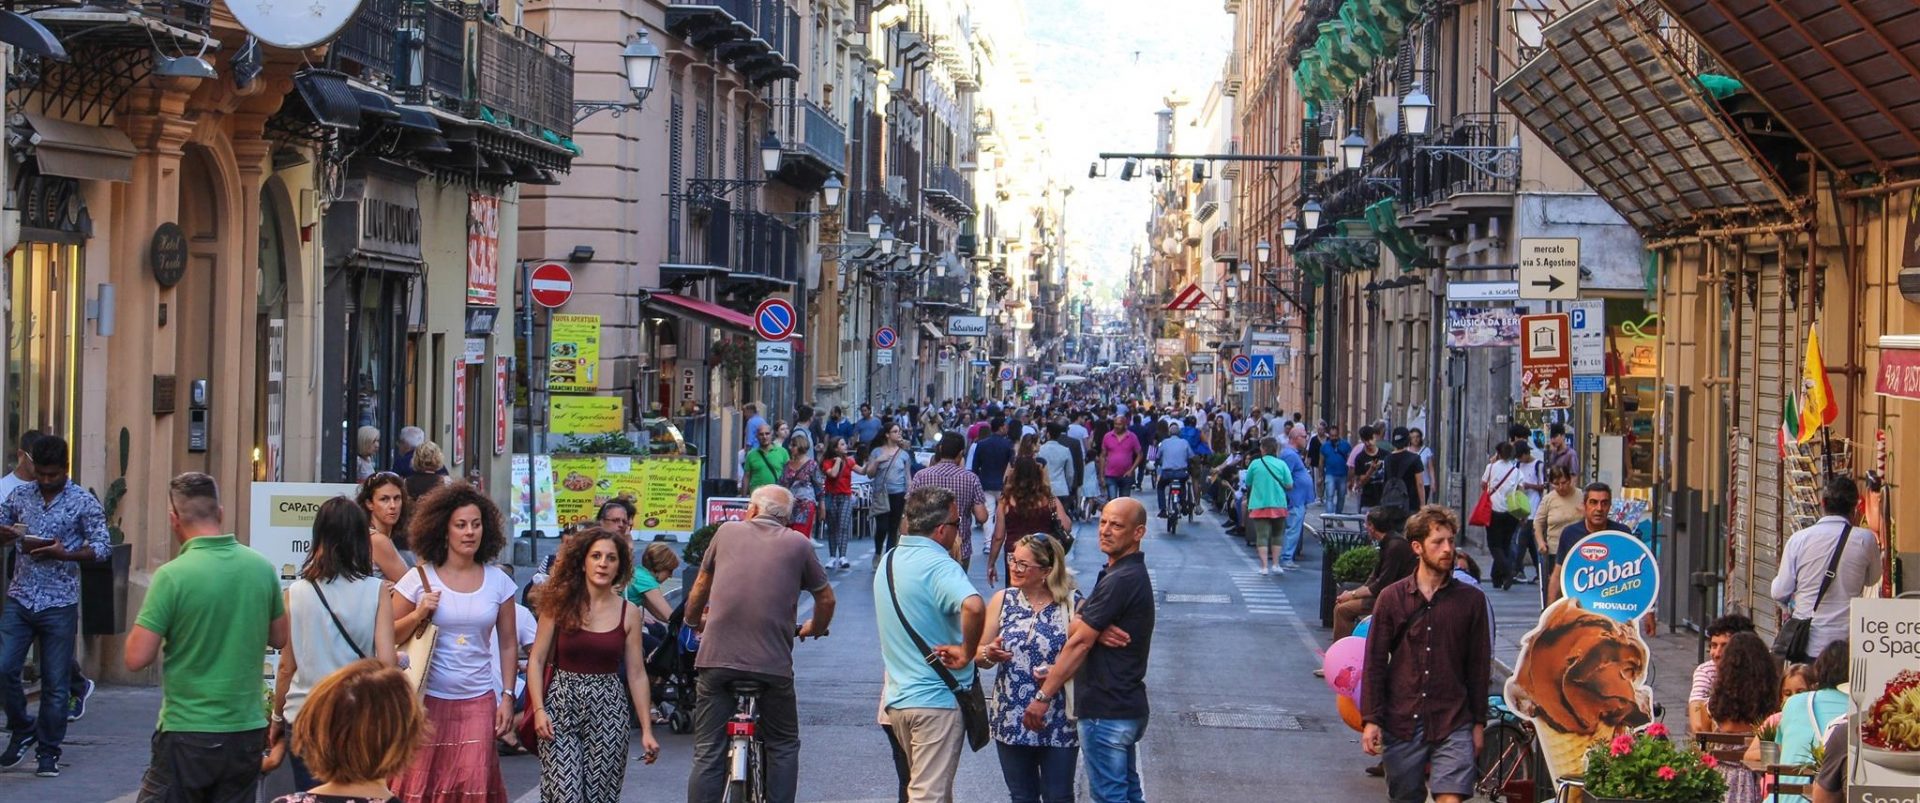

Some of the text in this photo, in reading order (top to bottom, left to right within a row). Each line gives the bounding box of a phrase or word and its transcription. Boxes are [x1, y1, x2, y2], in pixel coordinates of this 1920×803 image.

[1534, 245, 1565, 253] mercato
[1522, 258, 1534, 266] via
[1488, 318, 1500, 327] DA
[1502, 318, 1520, 326] BER
[1574, 311, 1583, 328] P
[1573, 553, 1647, 593] Ciobar
[1601, 579, 1641, 597] GELATO
[1593, 601, 1637, 611] PROVALO!
[1861, 617, 1920, 635] Ice cre
[1862, 640, 1875, 653] o
